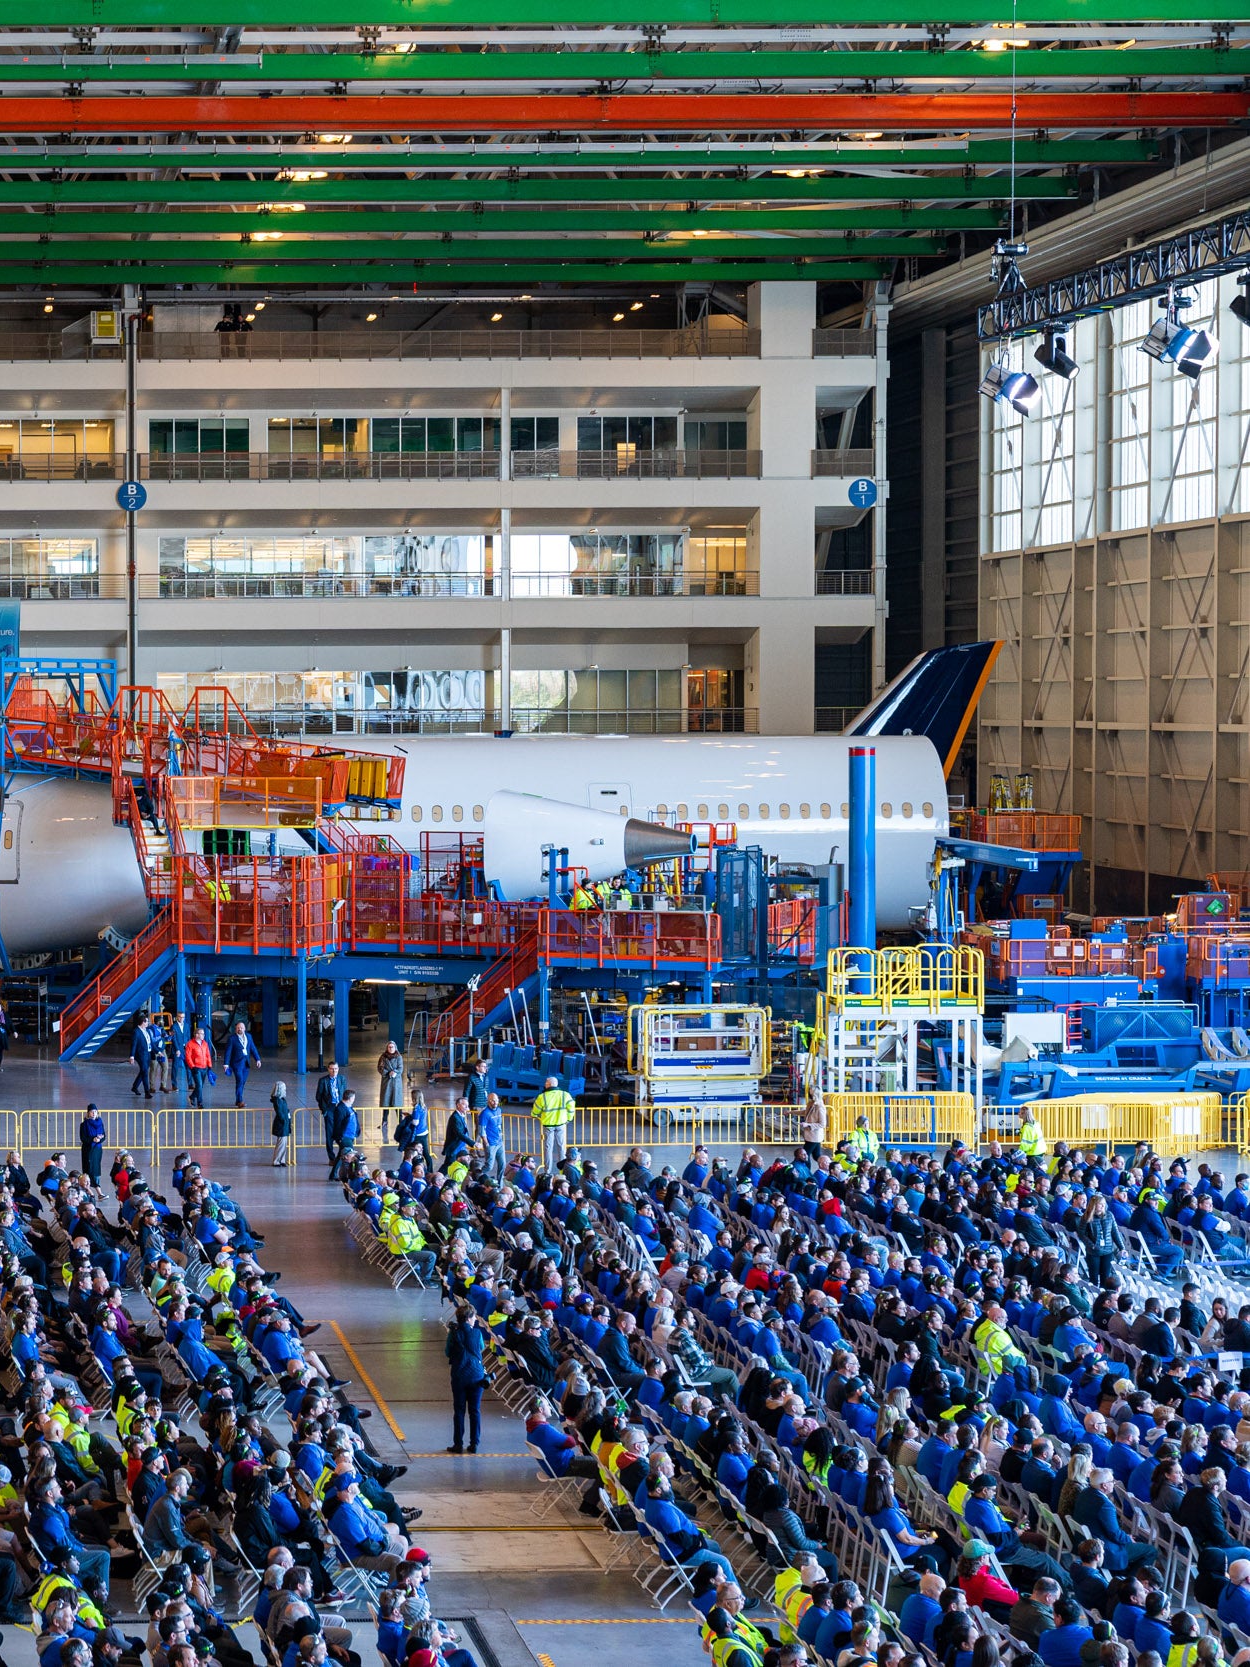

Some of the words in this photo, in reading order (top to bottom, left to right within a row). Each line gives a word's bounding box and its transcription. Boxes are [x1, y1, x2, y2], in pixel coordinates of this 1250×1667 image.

[128, 484, 137, 495] B
[859, 481, 867, 491] B
[128, 498, 136, 508] 2
[860, 494, 865, 505] 1
